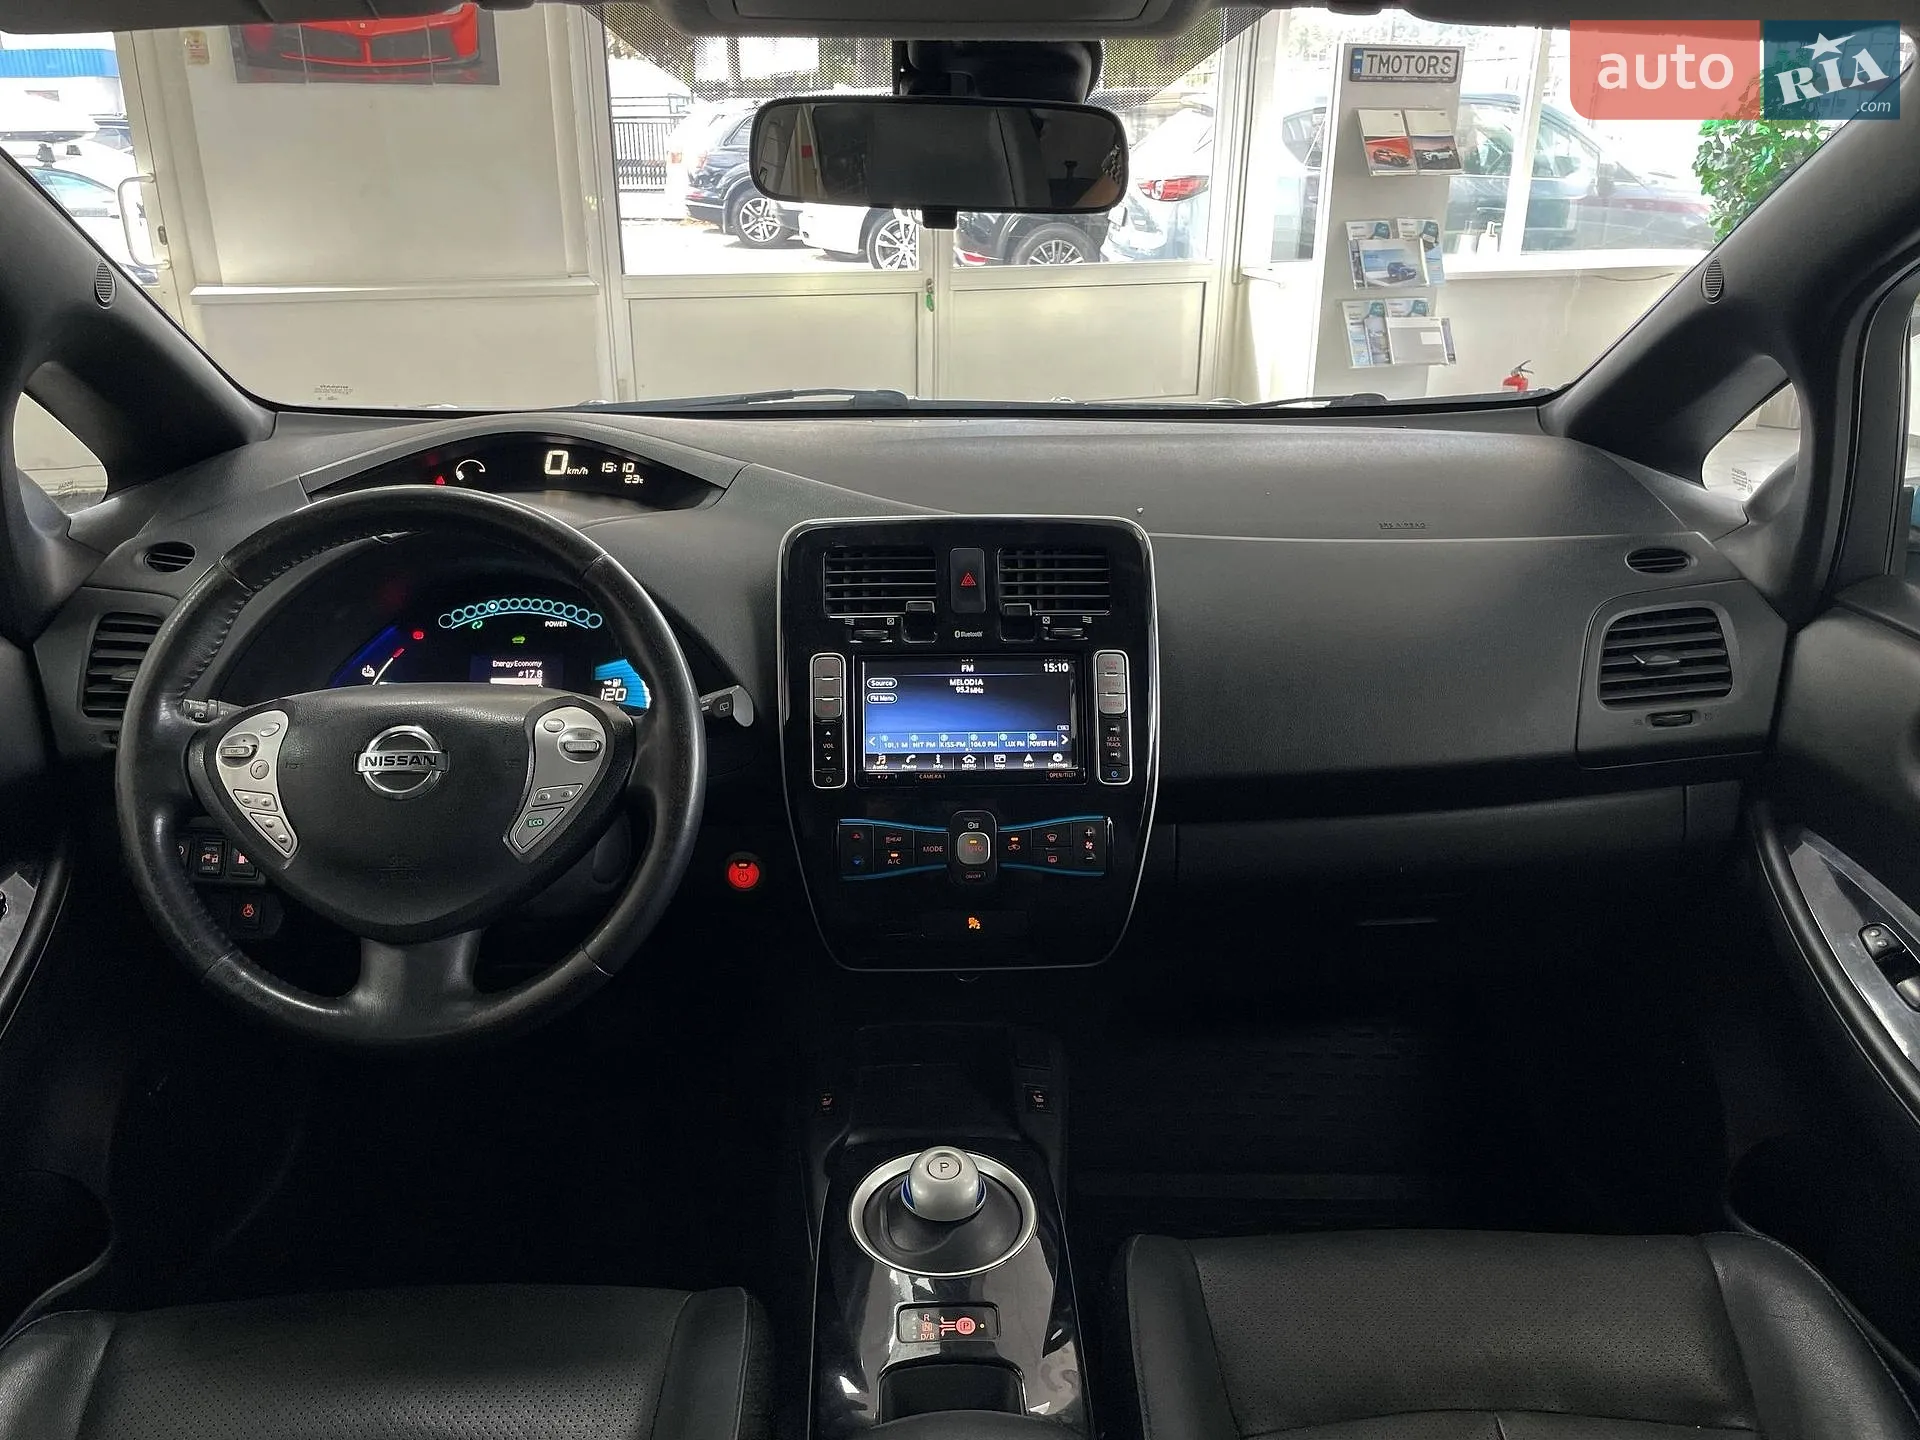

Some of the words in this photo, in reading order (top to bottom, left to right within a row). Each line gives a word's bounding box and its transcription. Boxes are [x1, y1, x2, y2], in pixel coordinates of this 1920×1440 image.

[1366, 54, 1452, 75] TMOTORS
[544, 449, 569, 475] 0
[567, 467, 589, 475] km/h
[492, 661, 514, 669] Energy
[961, 664, 974, 673] FM
[1043, 662, 1069, 673] 15:10
[601, 687, 627, 701] 120
[955, 686, 970, 694] 95.2
[364, 755, 437, 767] NISSAN
[528, 818, 544, 826] ECO
[922, 845, 944, 853] MODE
[939, 1162, 950, 1173] P
[923, 1313, 930, 1321] R
